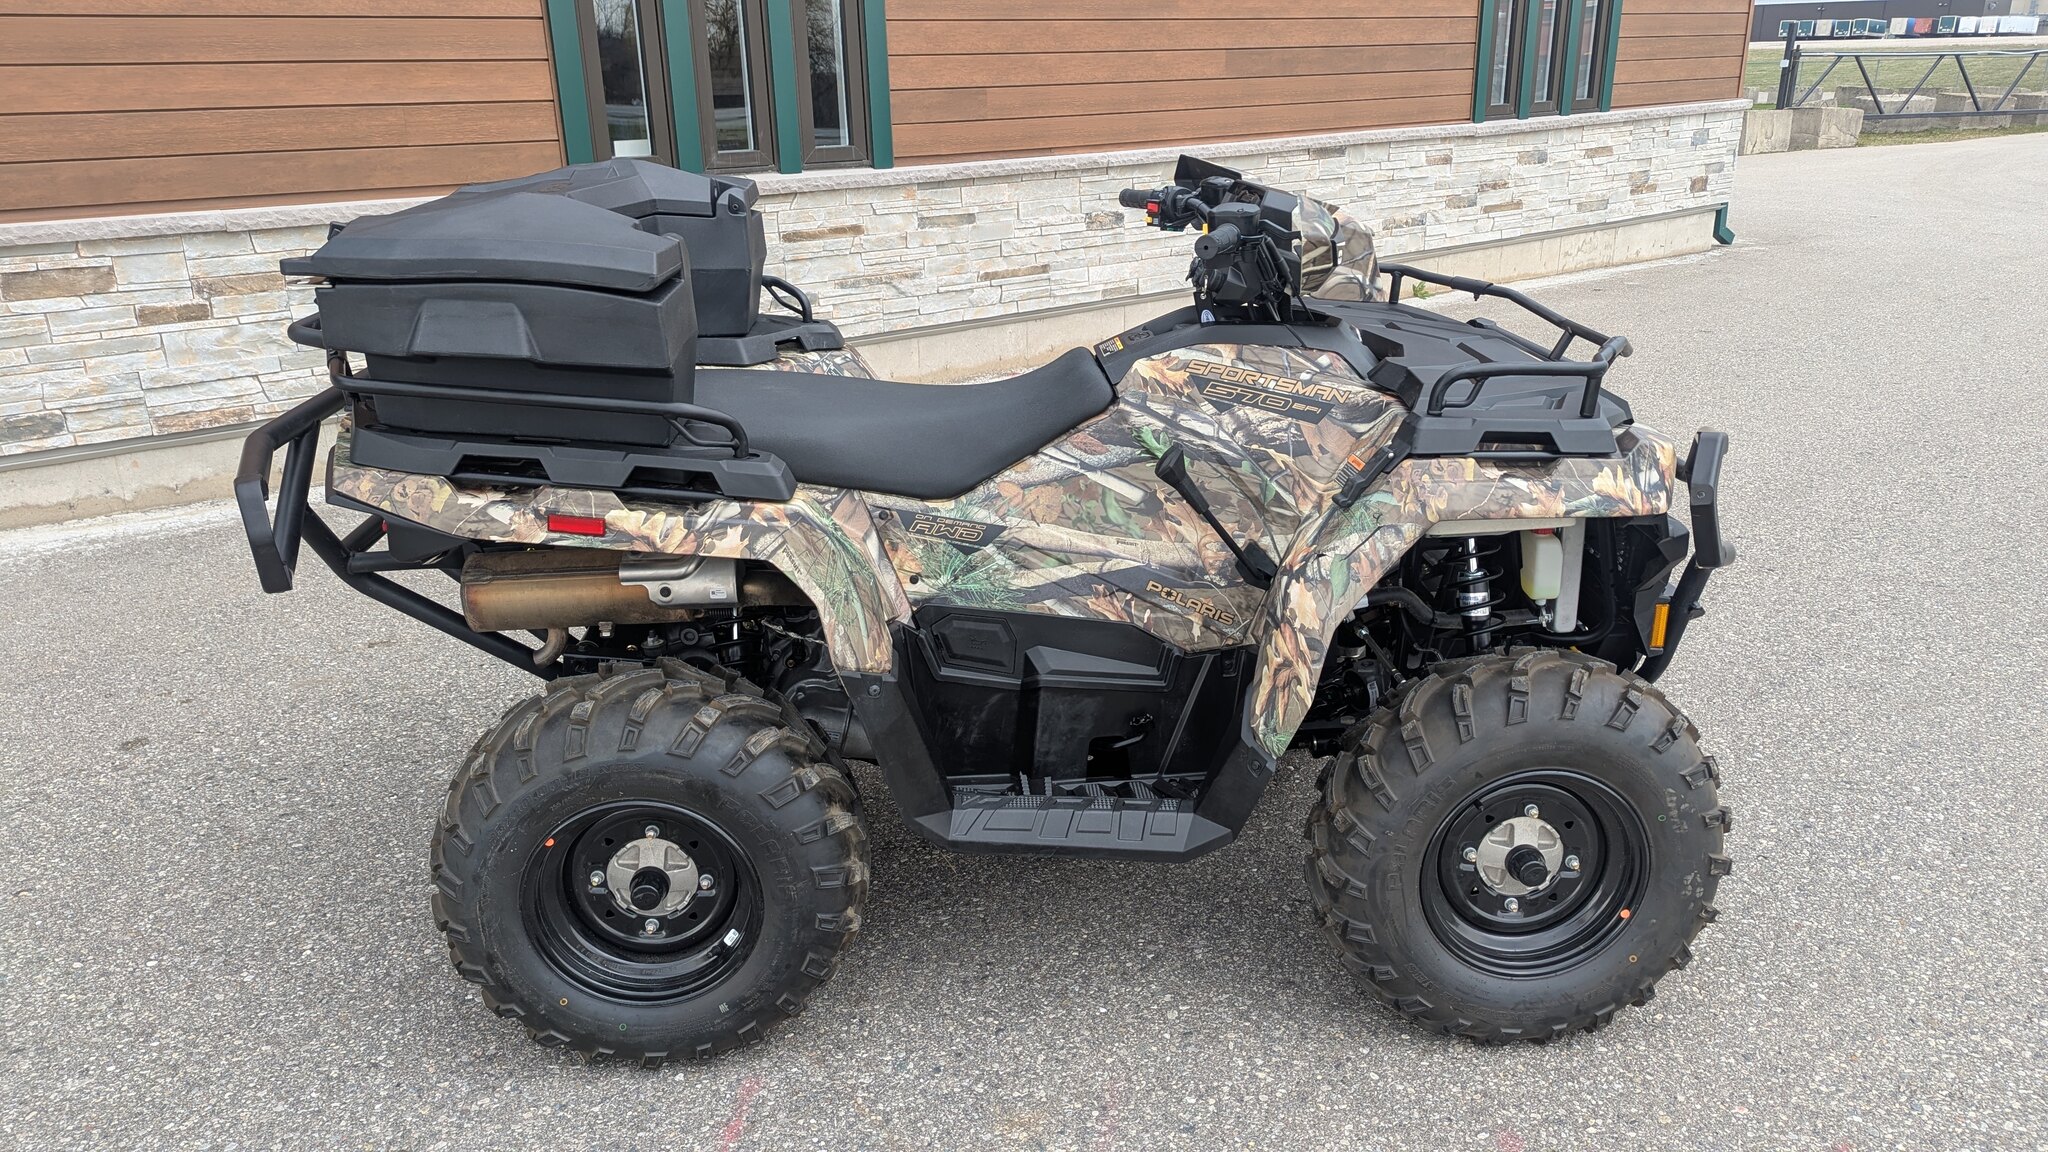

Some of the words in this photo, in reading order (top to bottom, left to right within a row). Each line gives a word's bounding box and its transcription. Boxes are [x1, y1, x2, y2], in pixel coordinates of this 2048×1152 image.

[1184, 359, 1351, 404] SPORTSMAN
[1203, 381, 1293, 411] 570
[1291, 402, 1322, 414] EFI
[909, 520, 984, 542] AWD
[937, 518, 987, 530] DEMAND
[1145, 580, 1236, 625] POLARIS
